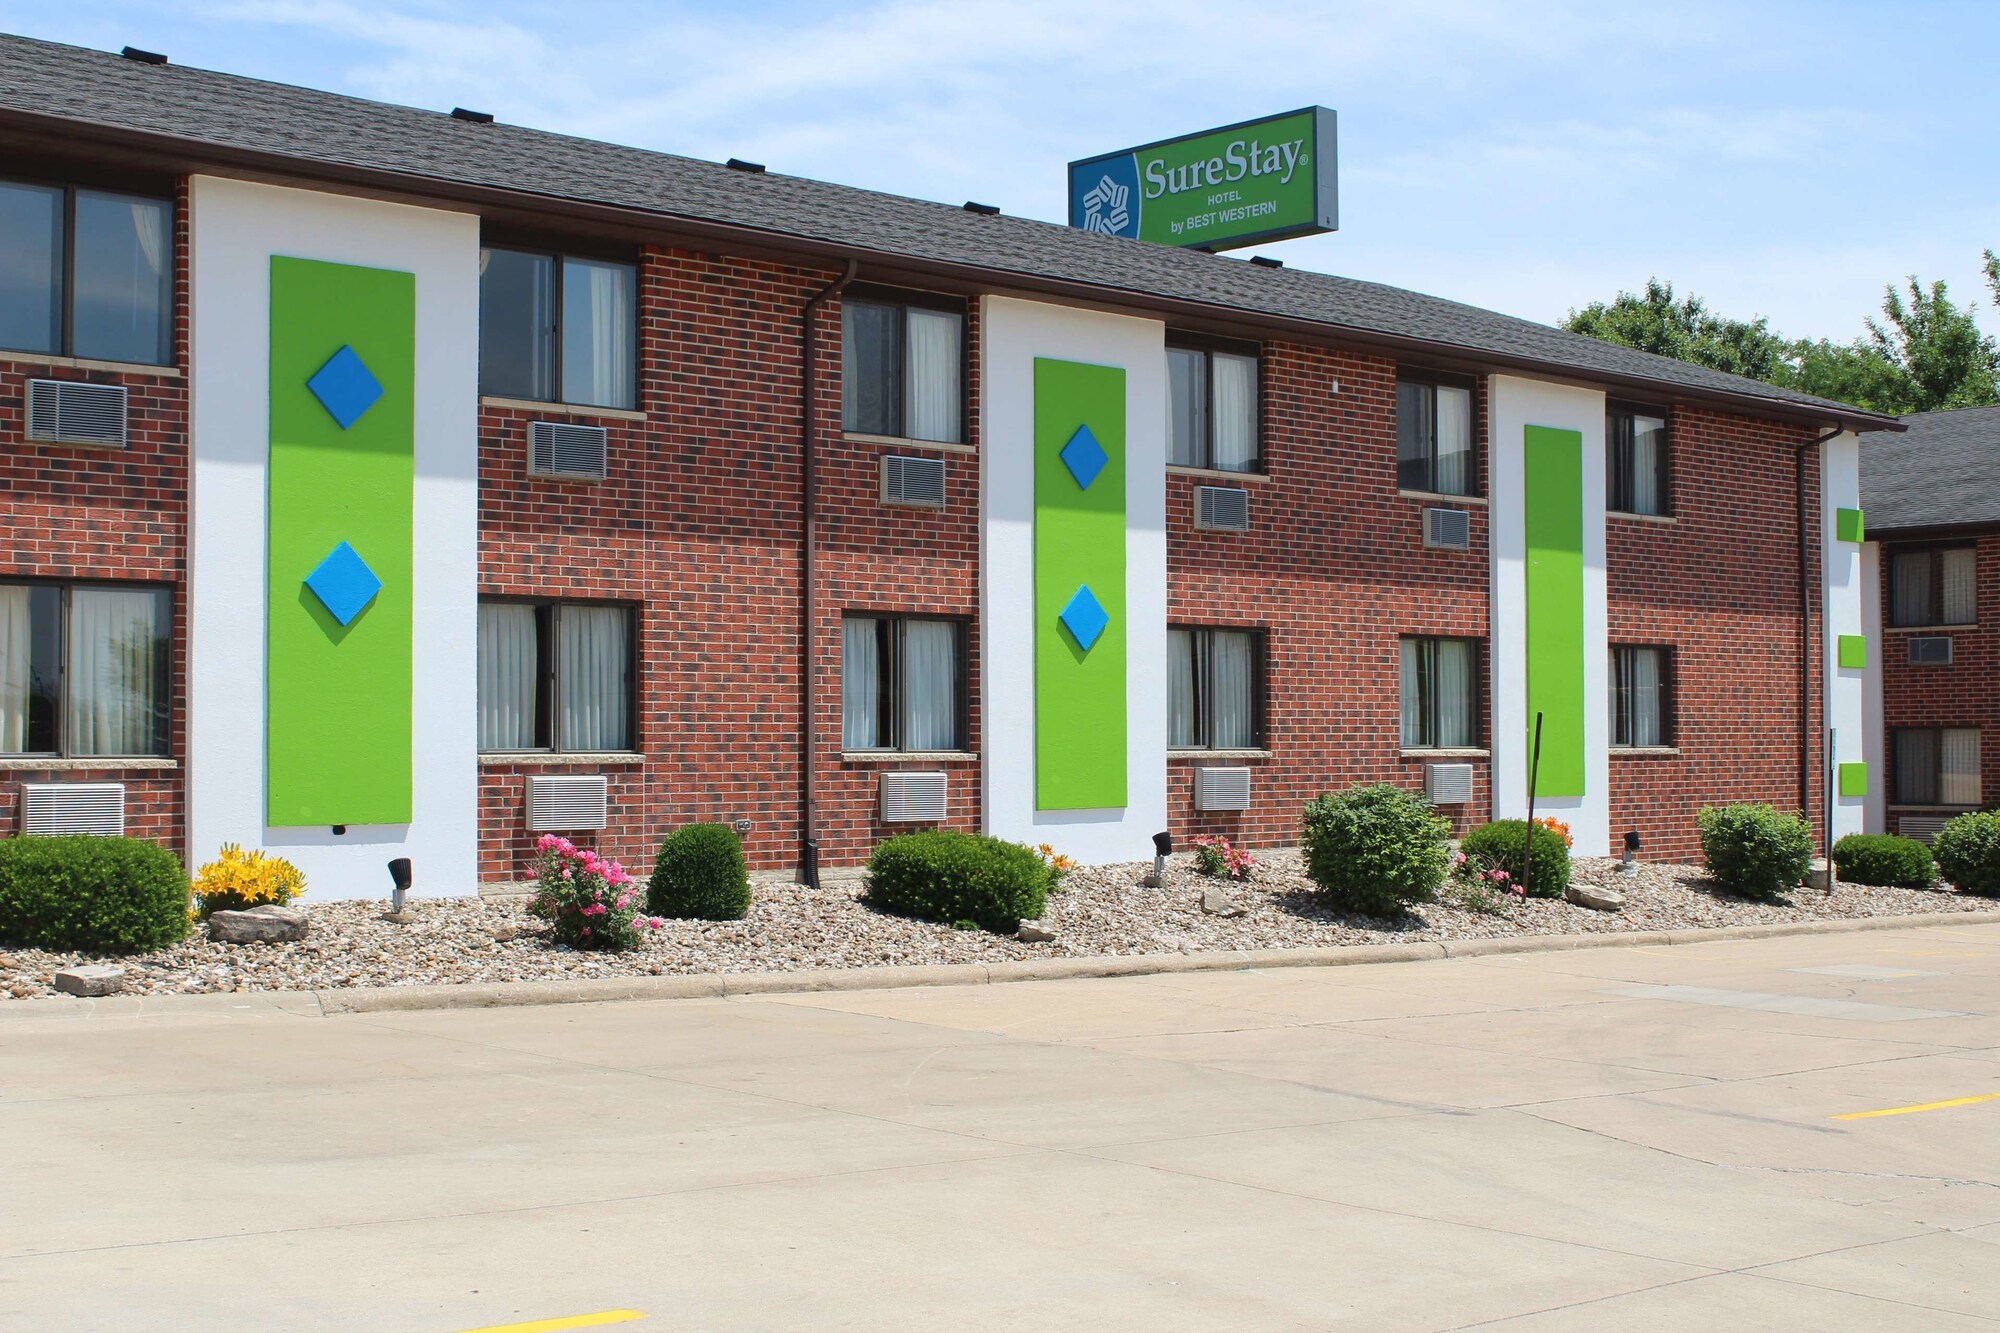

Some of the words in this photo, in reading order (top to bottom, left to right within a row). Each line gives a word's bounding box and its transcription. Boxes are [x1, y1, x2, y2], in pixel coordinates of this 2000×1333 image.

[1207, 190, 1242, 206] HOTEL
[1171, 220, 1184, 234] by
[1186, 213, 1216, 230] BEST
[1219, 200, 1277, 223] WESTERN
